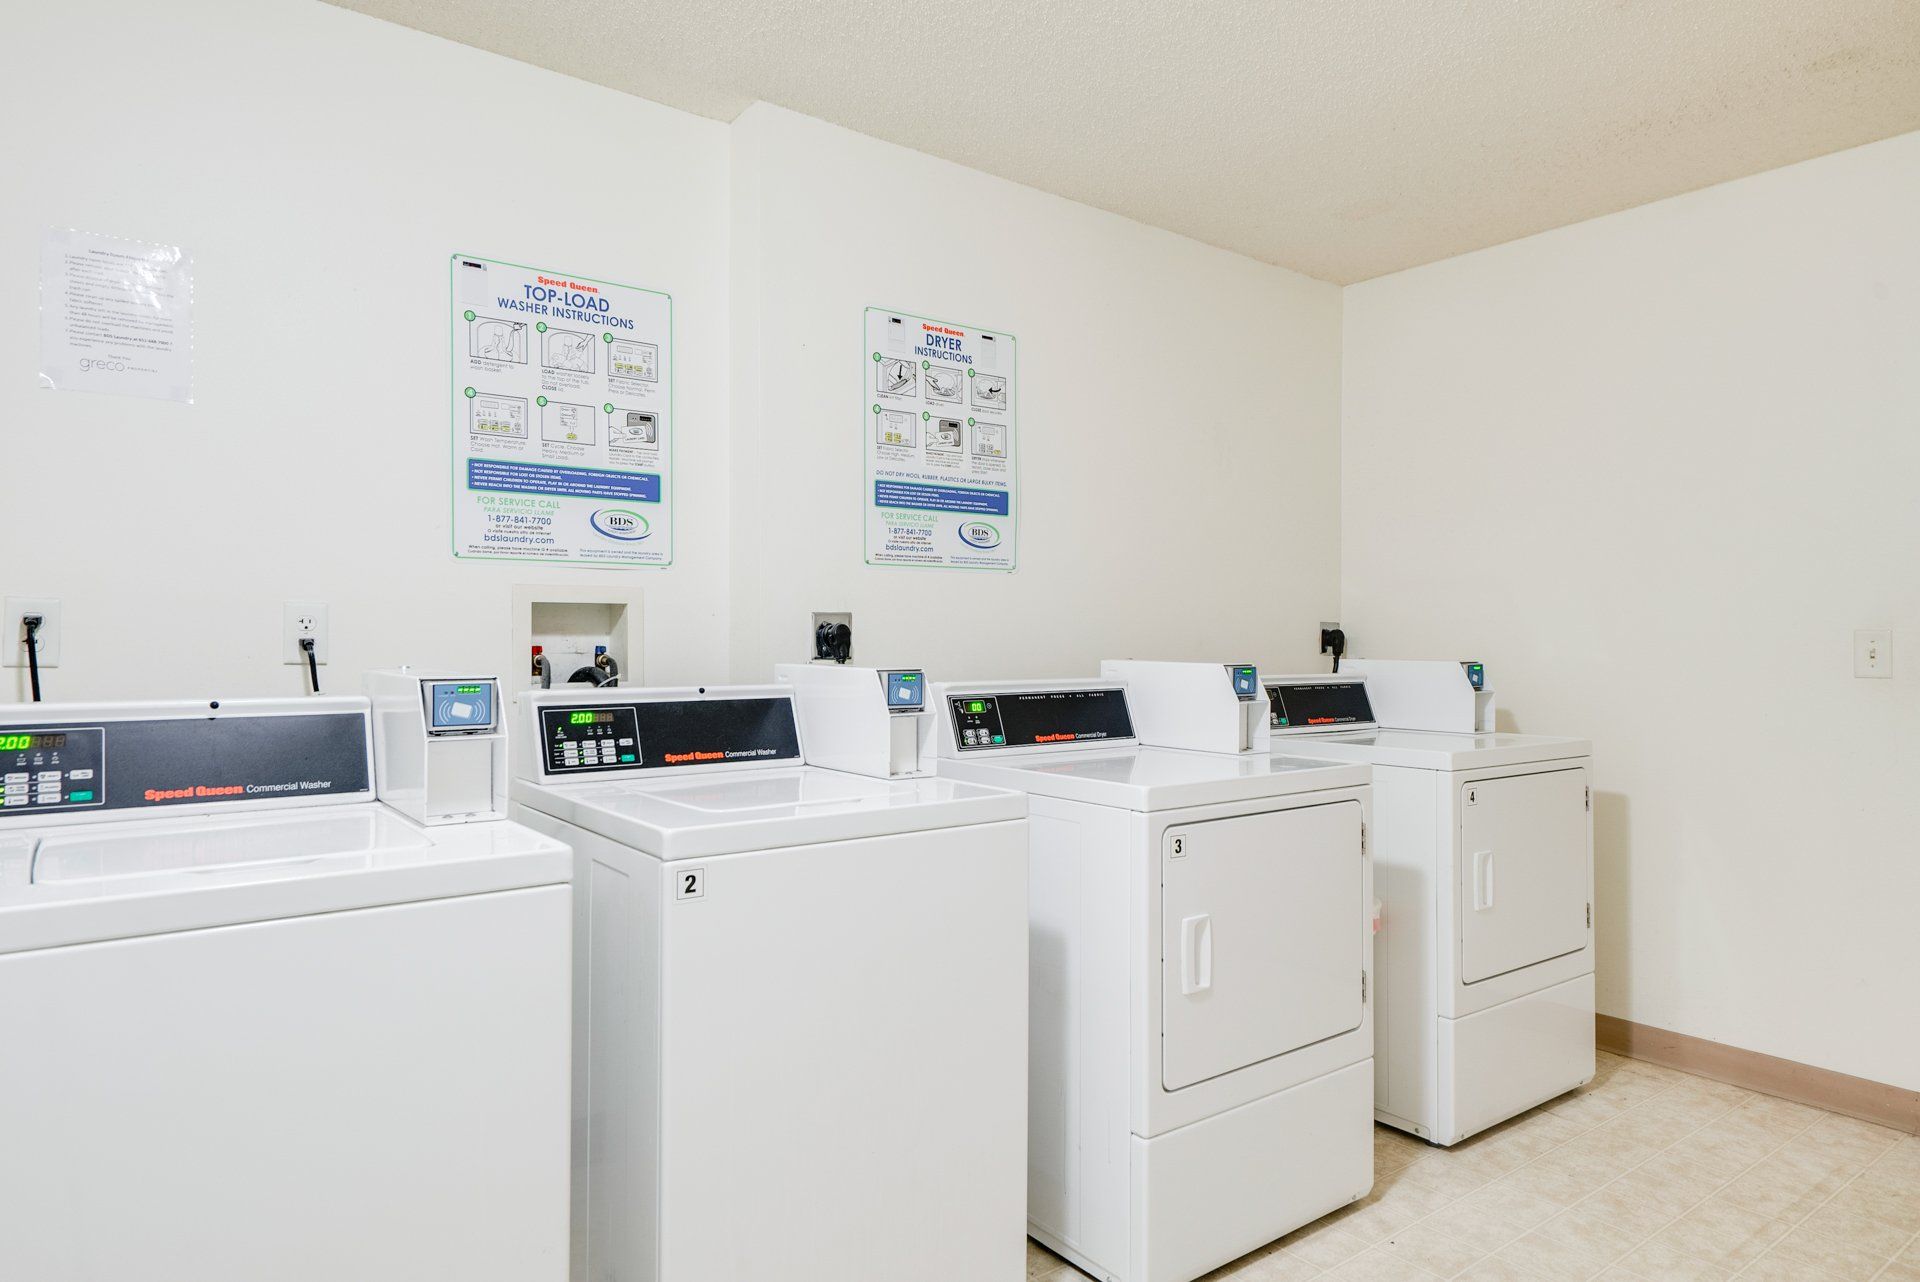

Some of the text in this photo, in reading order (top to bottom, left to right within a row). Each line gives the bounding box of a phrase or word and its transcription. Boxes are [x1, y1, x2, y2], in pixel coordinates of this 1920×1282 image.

[537, 276, 598, 294] Speed Queen
[524, 285, 610, 312] TOP-LOAD
[498, 297, 634, 330] WASHER INSTRUCTIONS
[922, 324, 964, 337] Speed Queen
[926, 334, 962, 351] DRYER
[915, 346, 973, 365] INSTRUCTIONS
[80, 358, 125, 372] greco
[477, 496, 560, 509] FOR SERVICE CALL
[488, 515, 552, 525] 1-877-841-7700
[610, 517, 634, 526] BDS
[896, 513, 922, 521] SERVICE
[888, 528, 932, 536] 1-877-841-7700
[972, 528, 989, 537] BDS
[484, 534, 555, 545] bdslaundry.com
[886, 544, 934, 552] bdslaundry.com
[972, 703, 982, 711] 00
[571, 713, 593, 724] 2.00
[1035, 734, 1055, 742] Speed
[665, 748, 777, 763] Speed Queen Commercial Washer
[144, 780, 332, 801] Speed Queen Commercial Washer
[1470, 791, 1475, 803] 4
[1175, 839, 1182, 854] 3
[685, 875, 696, 894] 2
